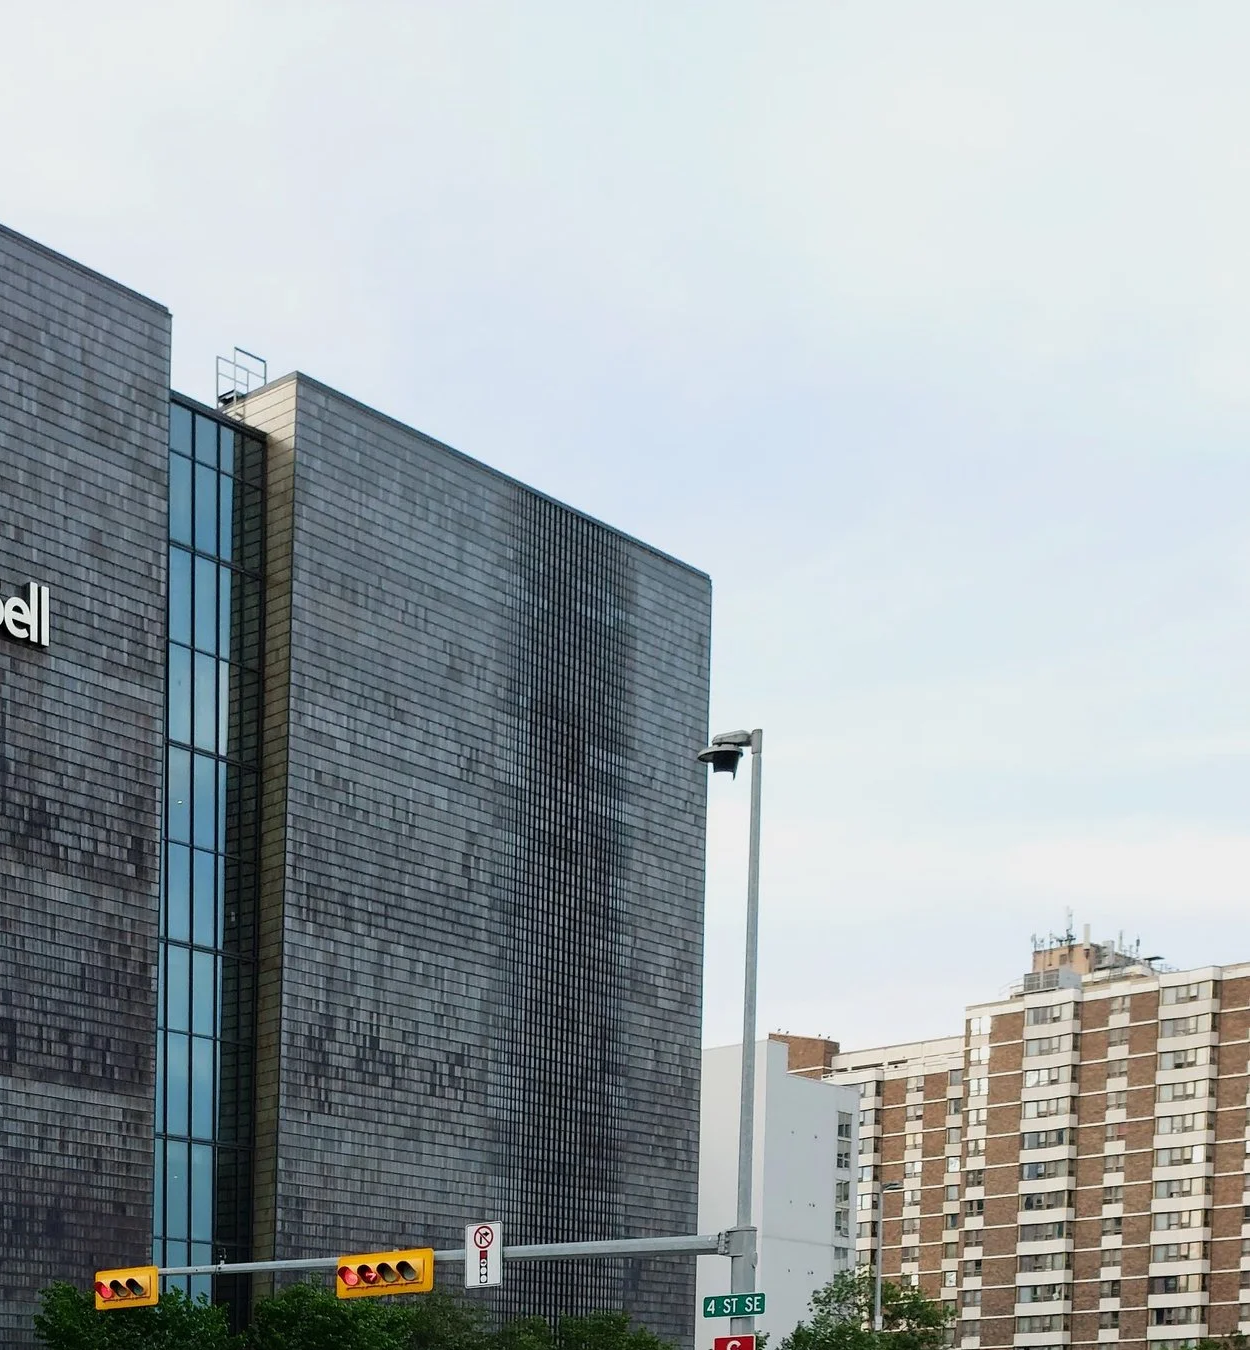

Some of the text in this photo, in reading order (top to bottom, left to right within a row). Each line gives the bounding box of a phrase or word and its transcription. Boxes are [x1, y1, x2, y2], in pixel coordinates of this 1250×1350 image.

[707, 1296, 762, 1314] 4 ST SE
